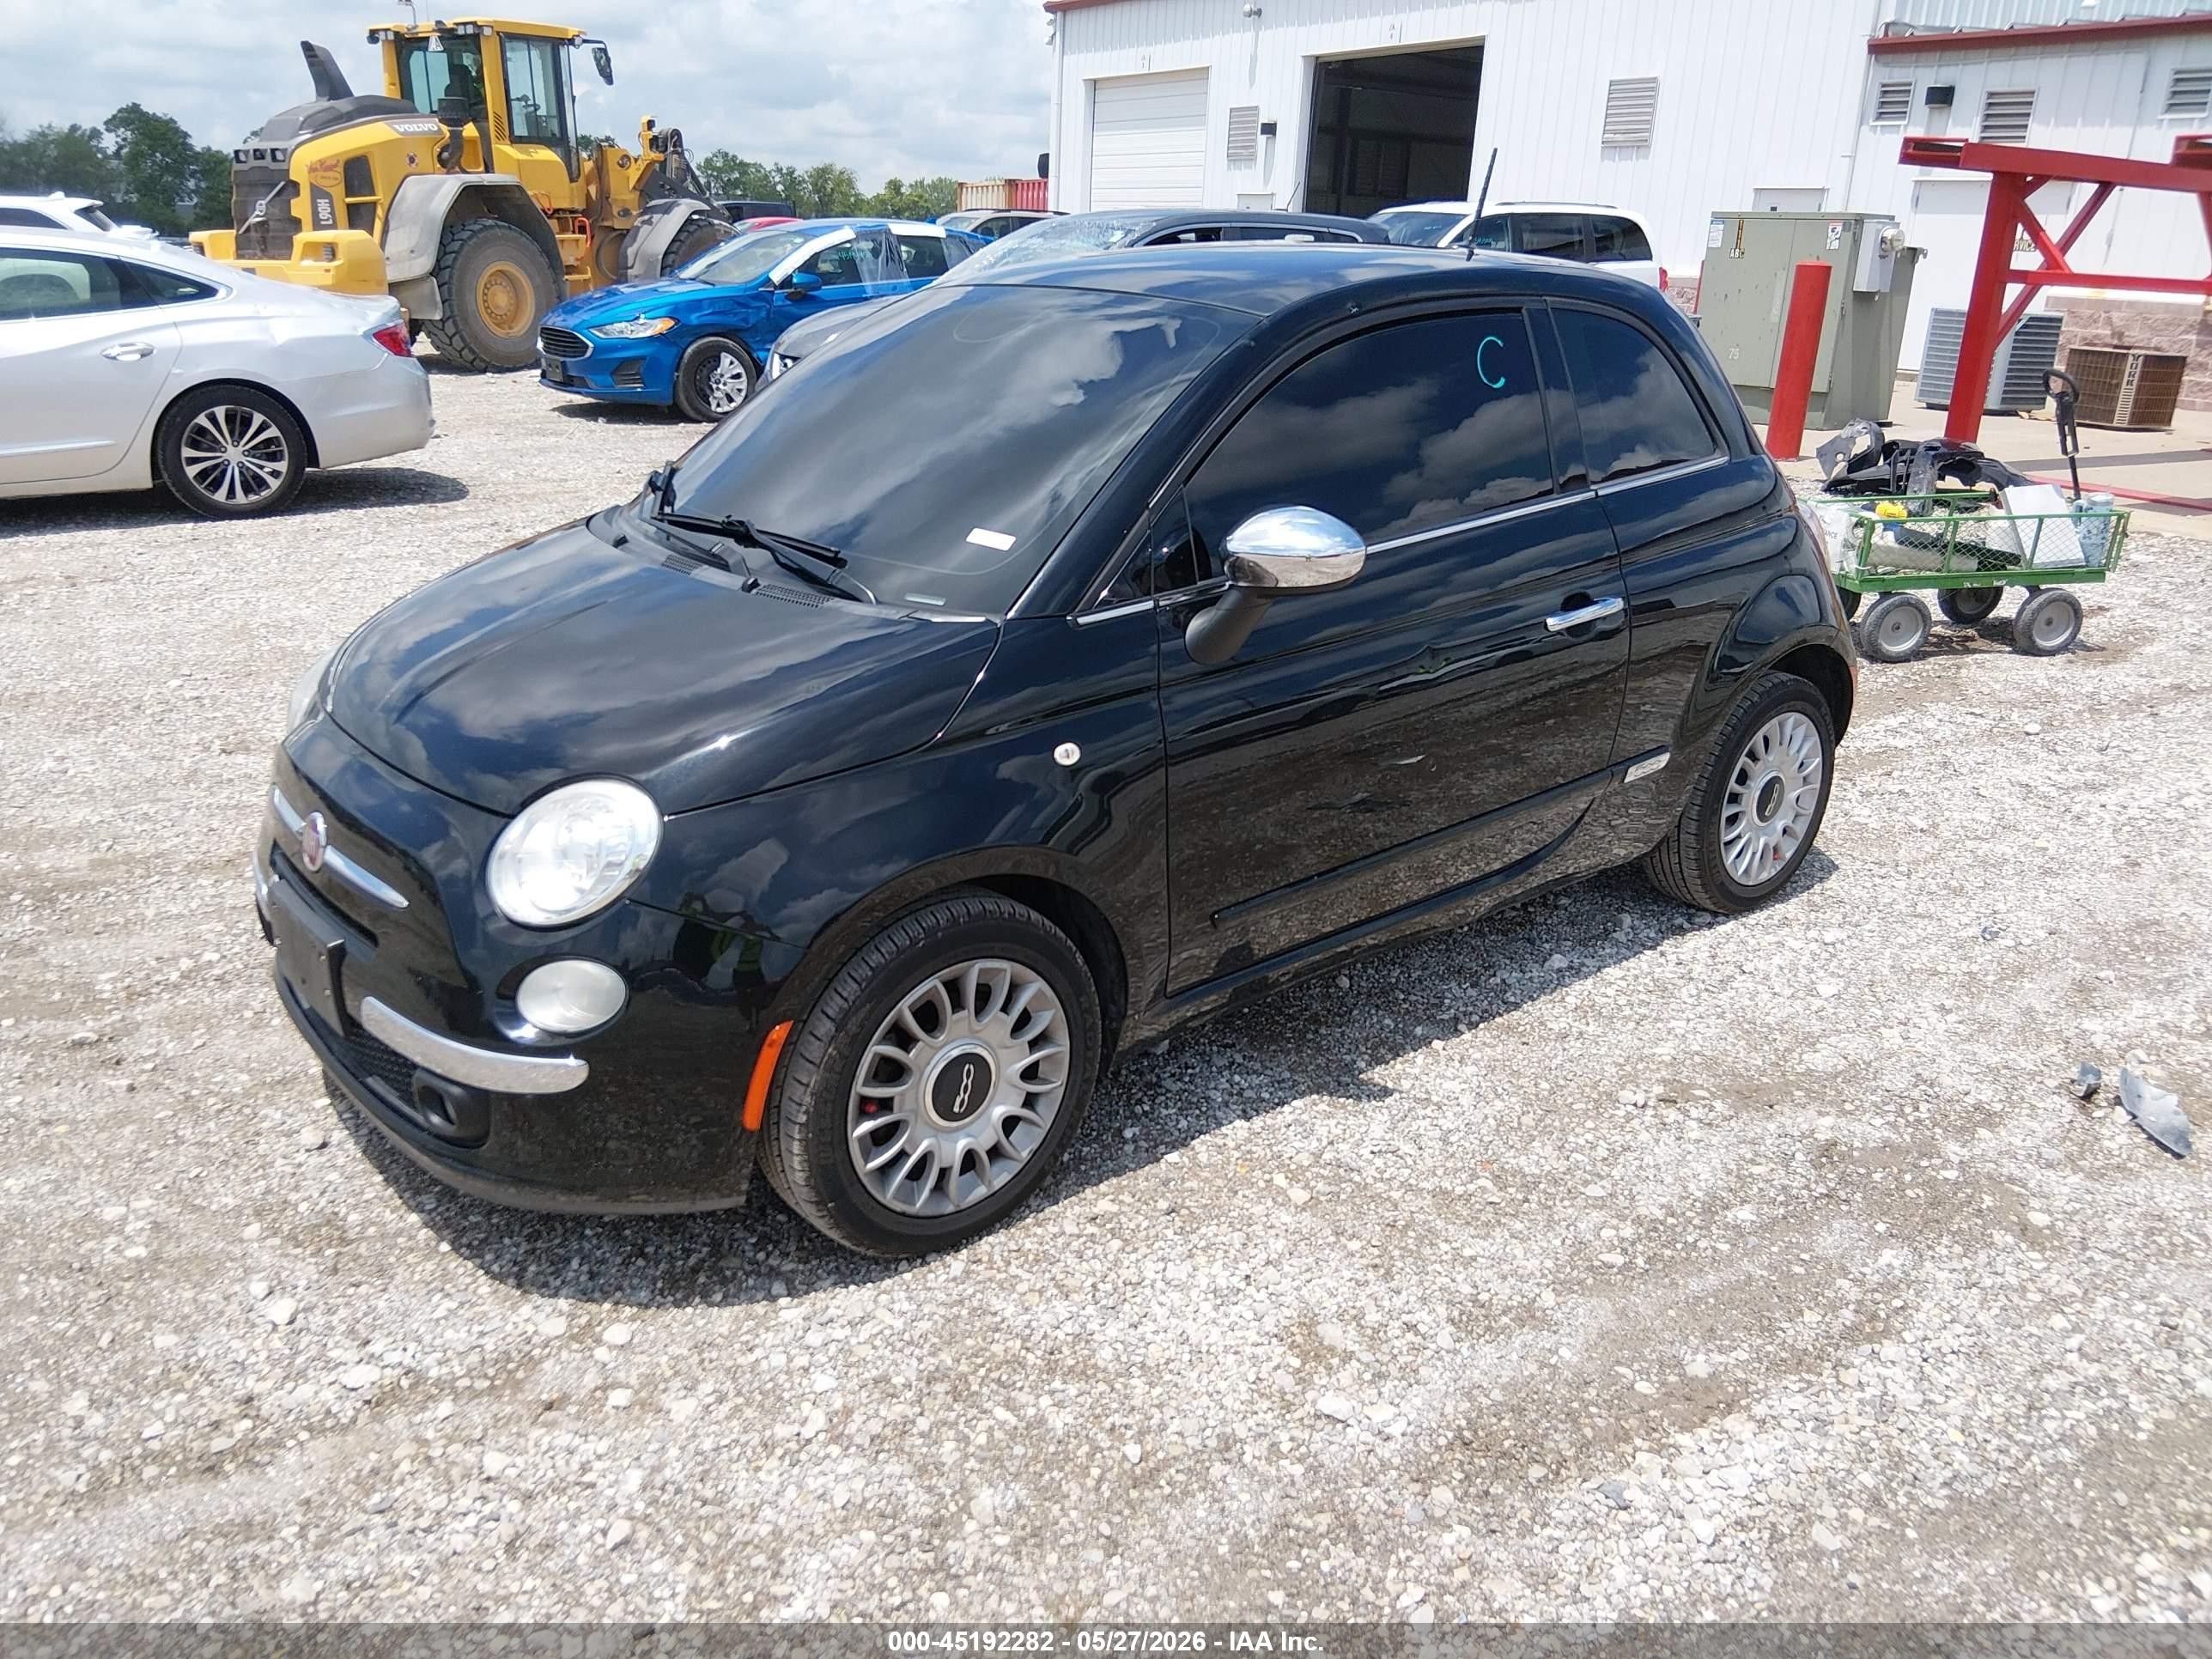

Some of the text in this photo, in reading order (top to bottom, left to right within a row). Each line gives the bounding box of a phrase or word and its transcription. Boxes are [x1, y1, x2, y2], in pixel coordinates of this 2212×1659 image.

[393, 123, 438, 132] VOLVO
[318, 198, 333, 225] L90H
[1729, 248, 1745, 258] ABC
[1477, 328, 1505, 380] C
[1728, 348, 1740, 360] 75
[2125, 353, 2143, 386] YORK
